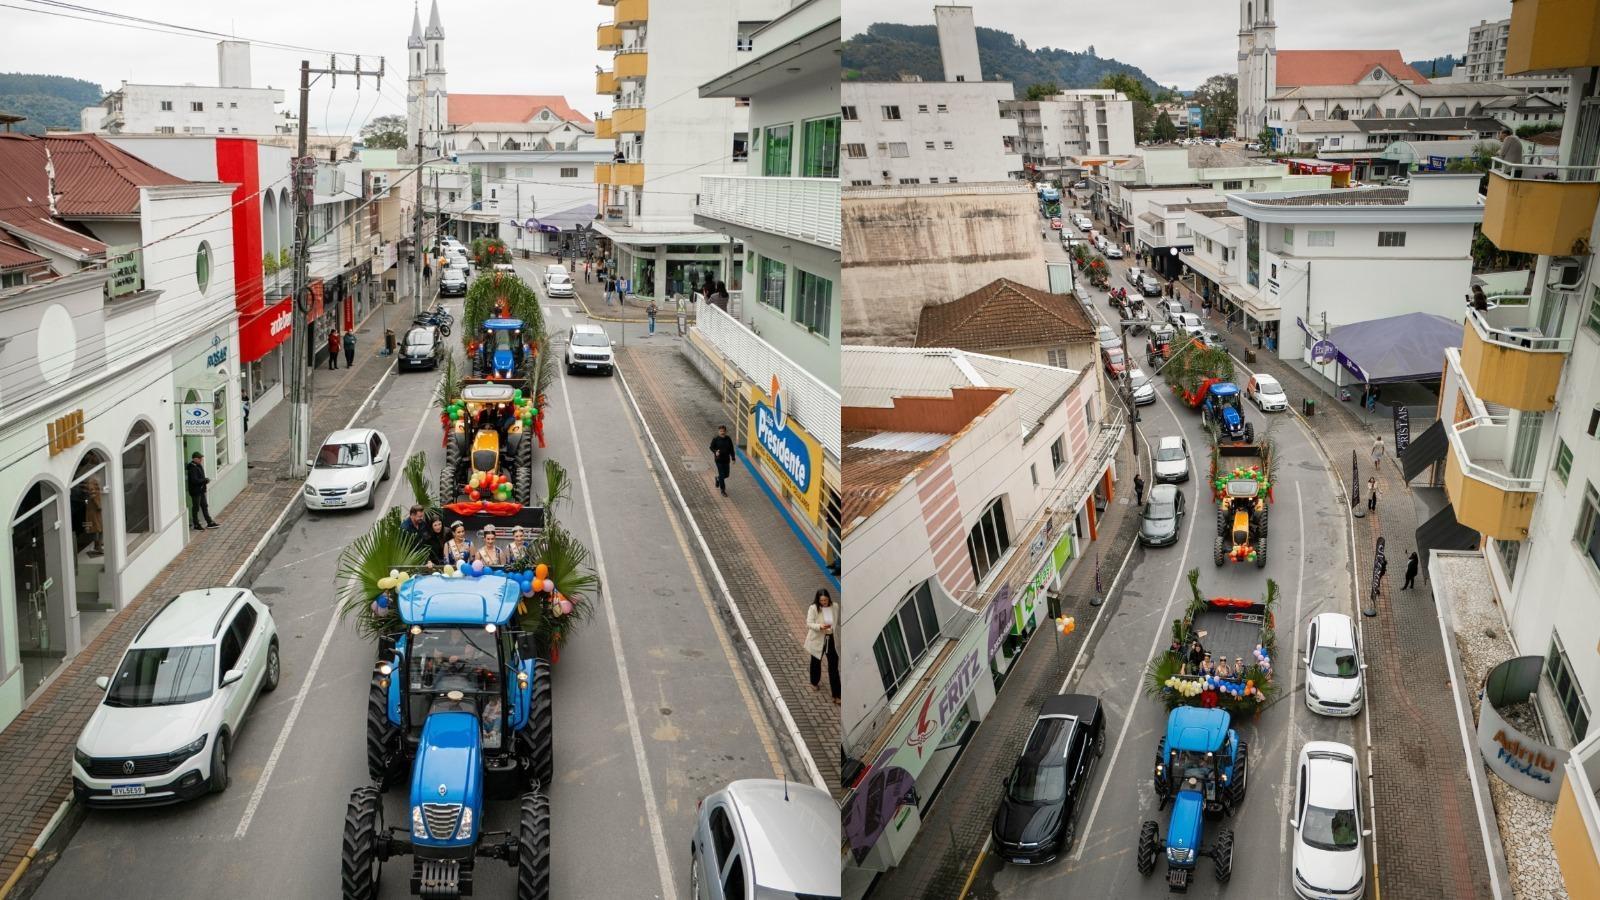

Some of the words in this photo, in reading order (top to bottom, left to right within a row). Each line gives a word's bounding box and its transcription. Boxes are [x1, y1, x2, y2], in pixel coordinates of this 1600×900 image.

[206, 346, 228, 367] ROSAR
[758, 407, 806, 487] Presidente
[1399, 406, 1409, 450] CRISTAIS
[939, 648, 980, 727] FRITZ
[1493, 730, 1555, 773] Adrilu
